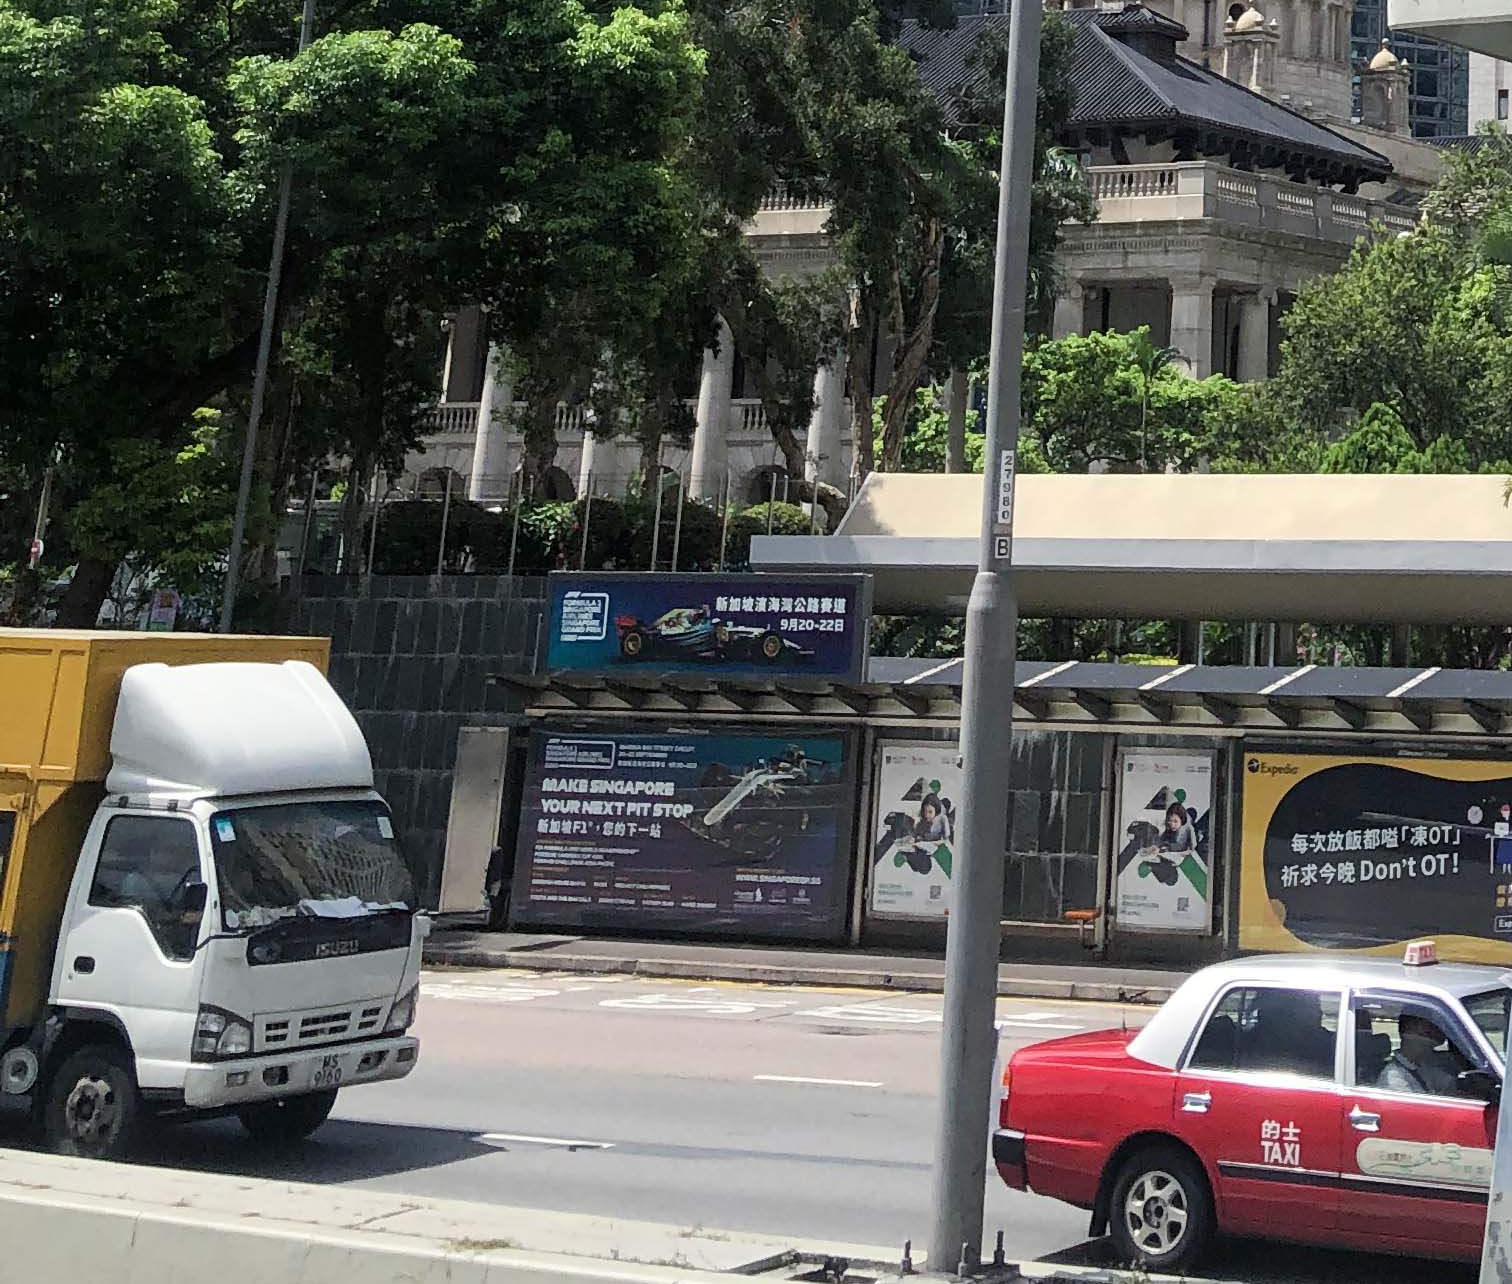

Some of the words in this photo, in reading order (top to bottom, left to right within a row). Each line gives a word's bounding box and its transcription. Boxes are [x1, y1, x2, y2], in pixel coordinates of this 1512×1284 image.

[1001, 455, 1013, 519] 27980
[997, 539, 1008, 556] B
[780, 618, 844, 632] 9月20-22日
[1261, 762, 1298, 776] Expedia
[541, 778, 588, 792] MAKE
[589, 780, 675, 796] SINGAPORE
[541, 799, 580, 813] YOUR
[582, 801, 625, 815] NEXT
[626, 803, 651, 816] PIT
[653, 803, 694, 818] STOP
[1281, 861, 1355, 887] 祈求今晚
[1360, 854, 1416, 881] Don't
[316, 939, 359, 957] ISUZU
[1261, 1119, 1300, 1142] 的士
[1261, 1141, 1300, 1166] TAXI
